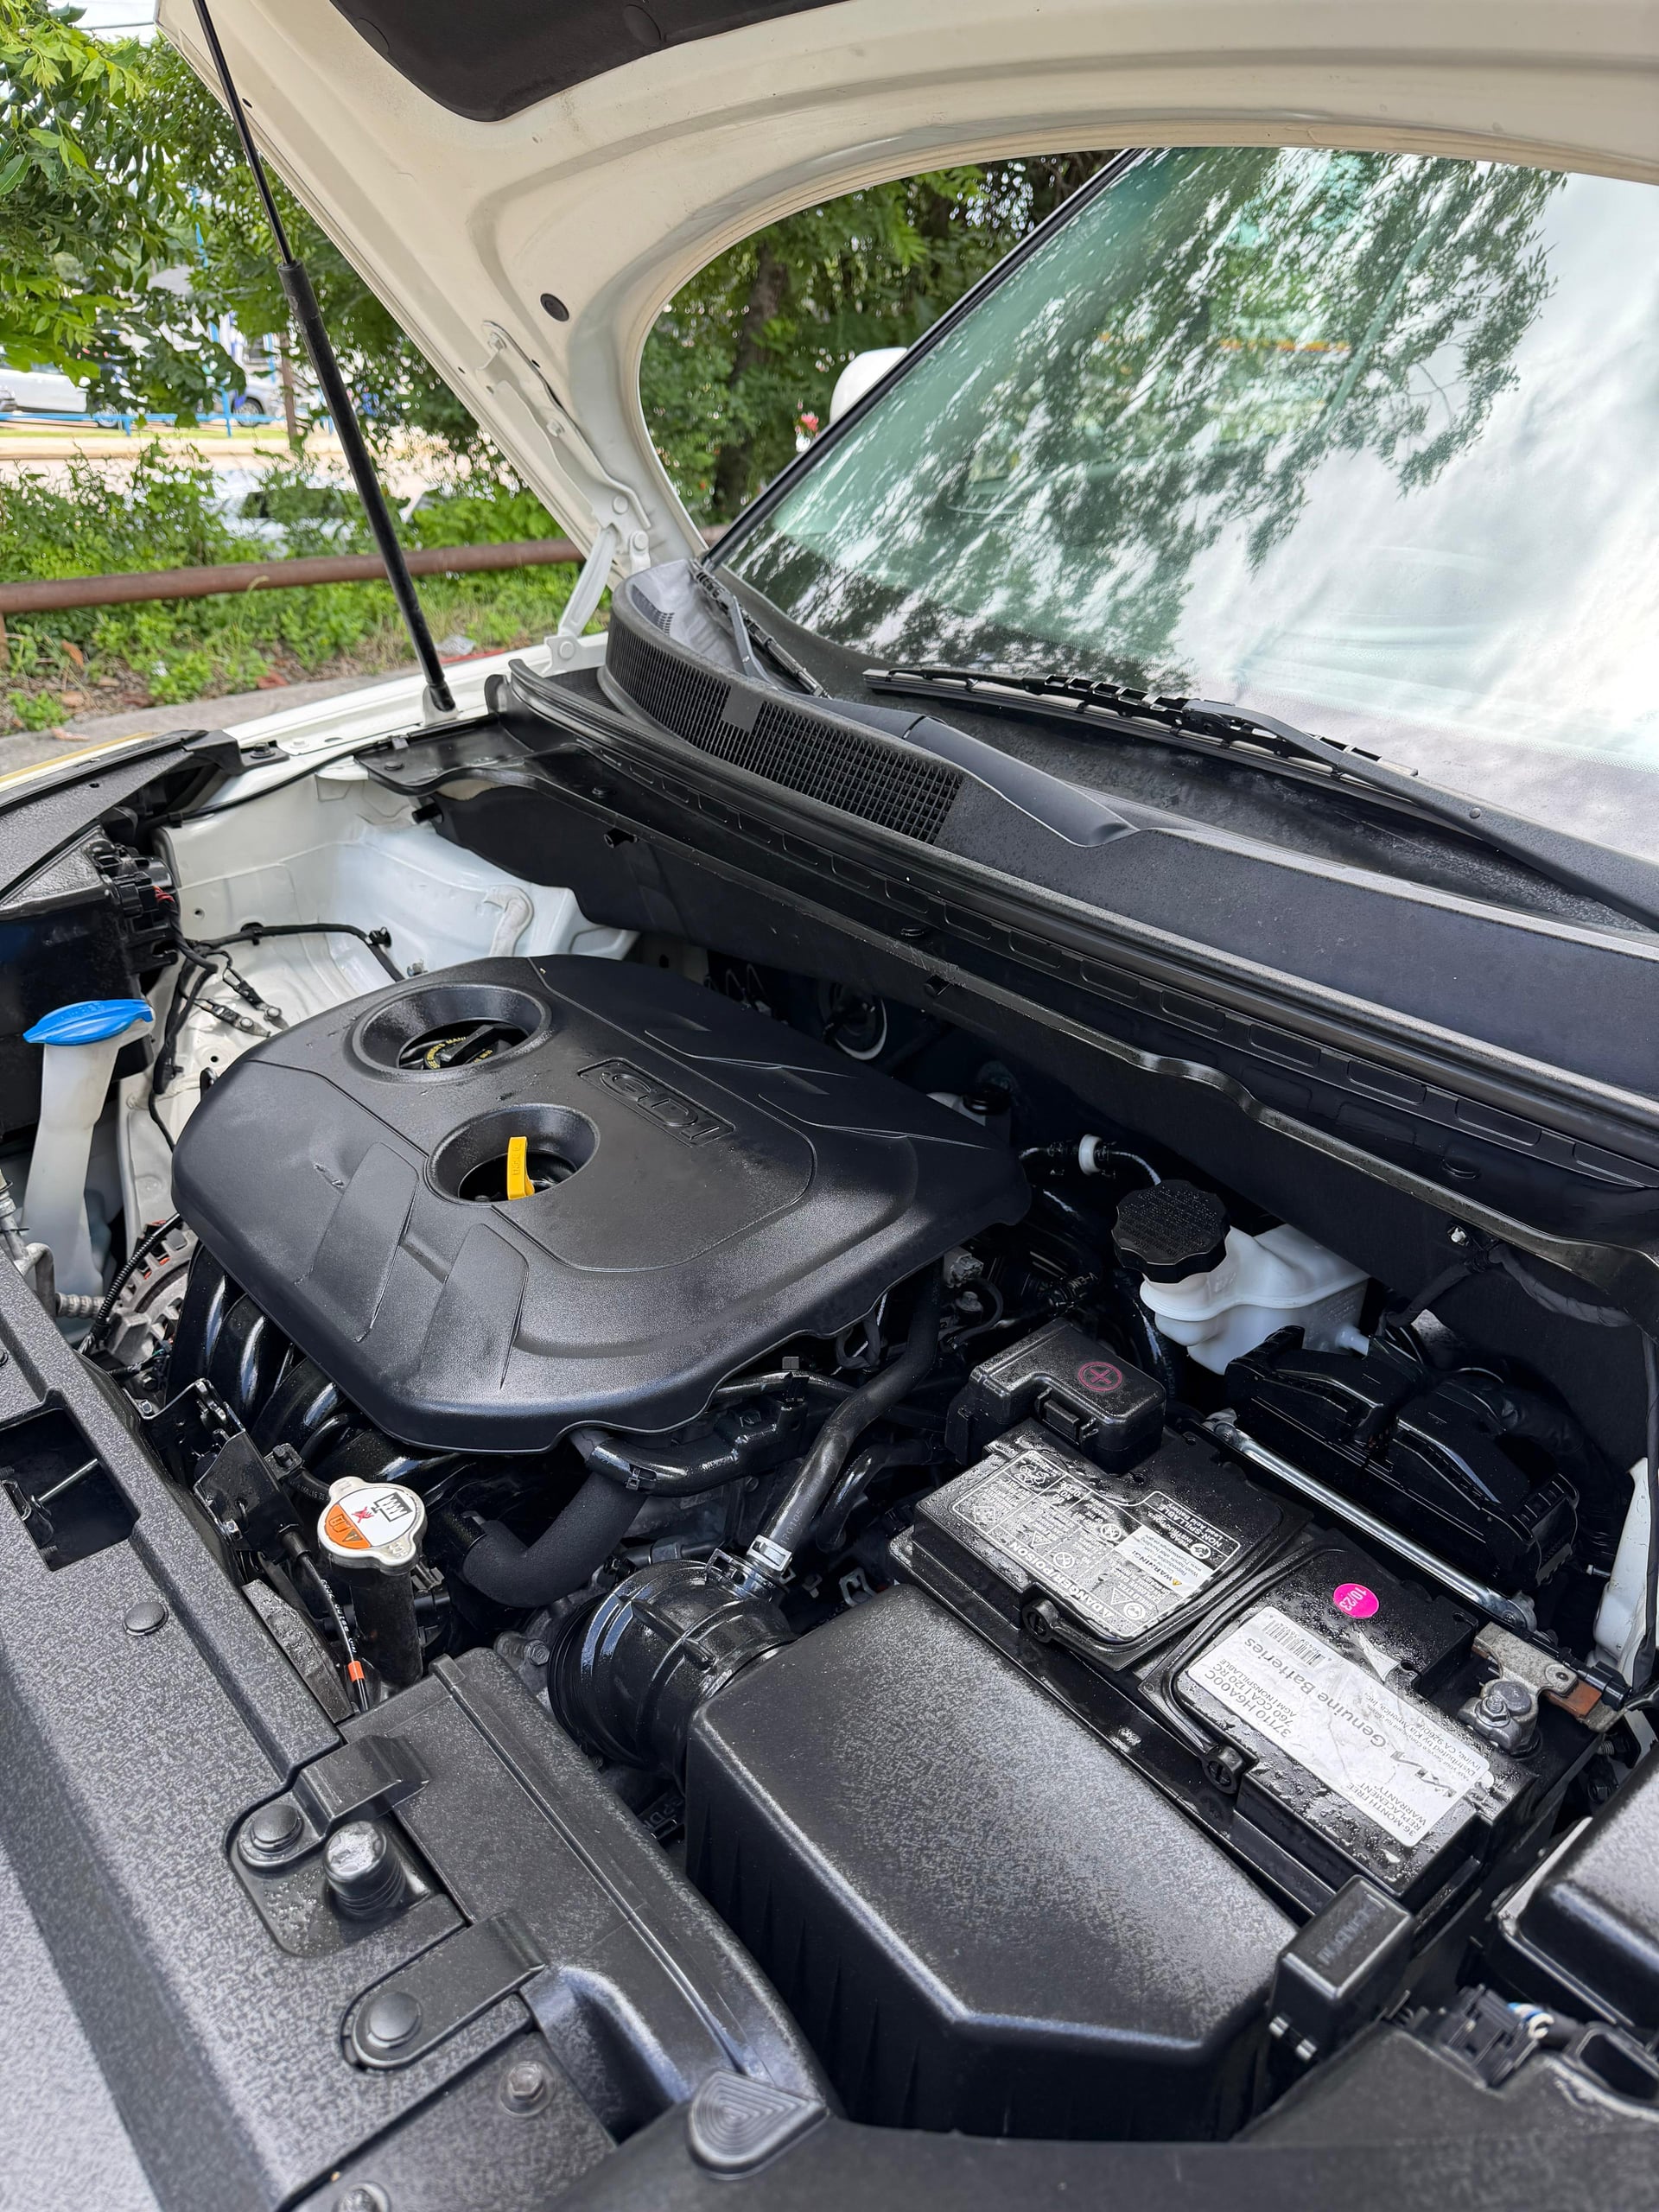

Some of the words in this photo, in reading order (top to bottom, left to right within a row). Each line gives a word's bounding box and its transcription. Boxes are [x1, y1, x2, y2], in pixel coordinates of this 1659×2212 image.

[1051, 1493, 1065, 1503] DO
[1156, 1504, 1223, 1547] NON-SPILLABLE
[1188, 1518, 1206, 1529] Acid
[1204, 1528, 1224, 1541] Lead
[1129, 1549, 1174, 1581] WARNING:
[1008, 1541, 1104, 1611] DANGER/POISON
[1338, 1586, 1367, 1611] 10/23
[1211, 1662, 1230, 1676] RC
[1239, 1637, 1317, 1694] Batteries
[1217, 1658, 1274, 1700] NONSPILLABLE
[1226, 1675, 1247, 1690] 120
[1249, 1691, 1274, 1712] CCA
[1275, 1701, 1297, 1718] AGM
[1254, 1708, 1292, 1738] 37110
[1271, 1708, 1294, 1726] 760
[1312, 1691, 1389, 1750] Genuine
[1408, 1726, 1423, 1738] Kia
[1420, 1734, 1434, 1746] by
[1442, 1742, 1458, 1754] CA
[1432, 1744, 1476, 1777] Distributed
[1345, 1782, 1370, 1801] FREE
[1357, 1781, 1422, 1831] REPLACEMENT
[1367, 1798, 1417, 1837] 36-MONTH
